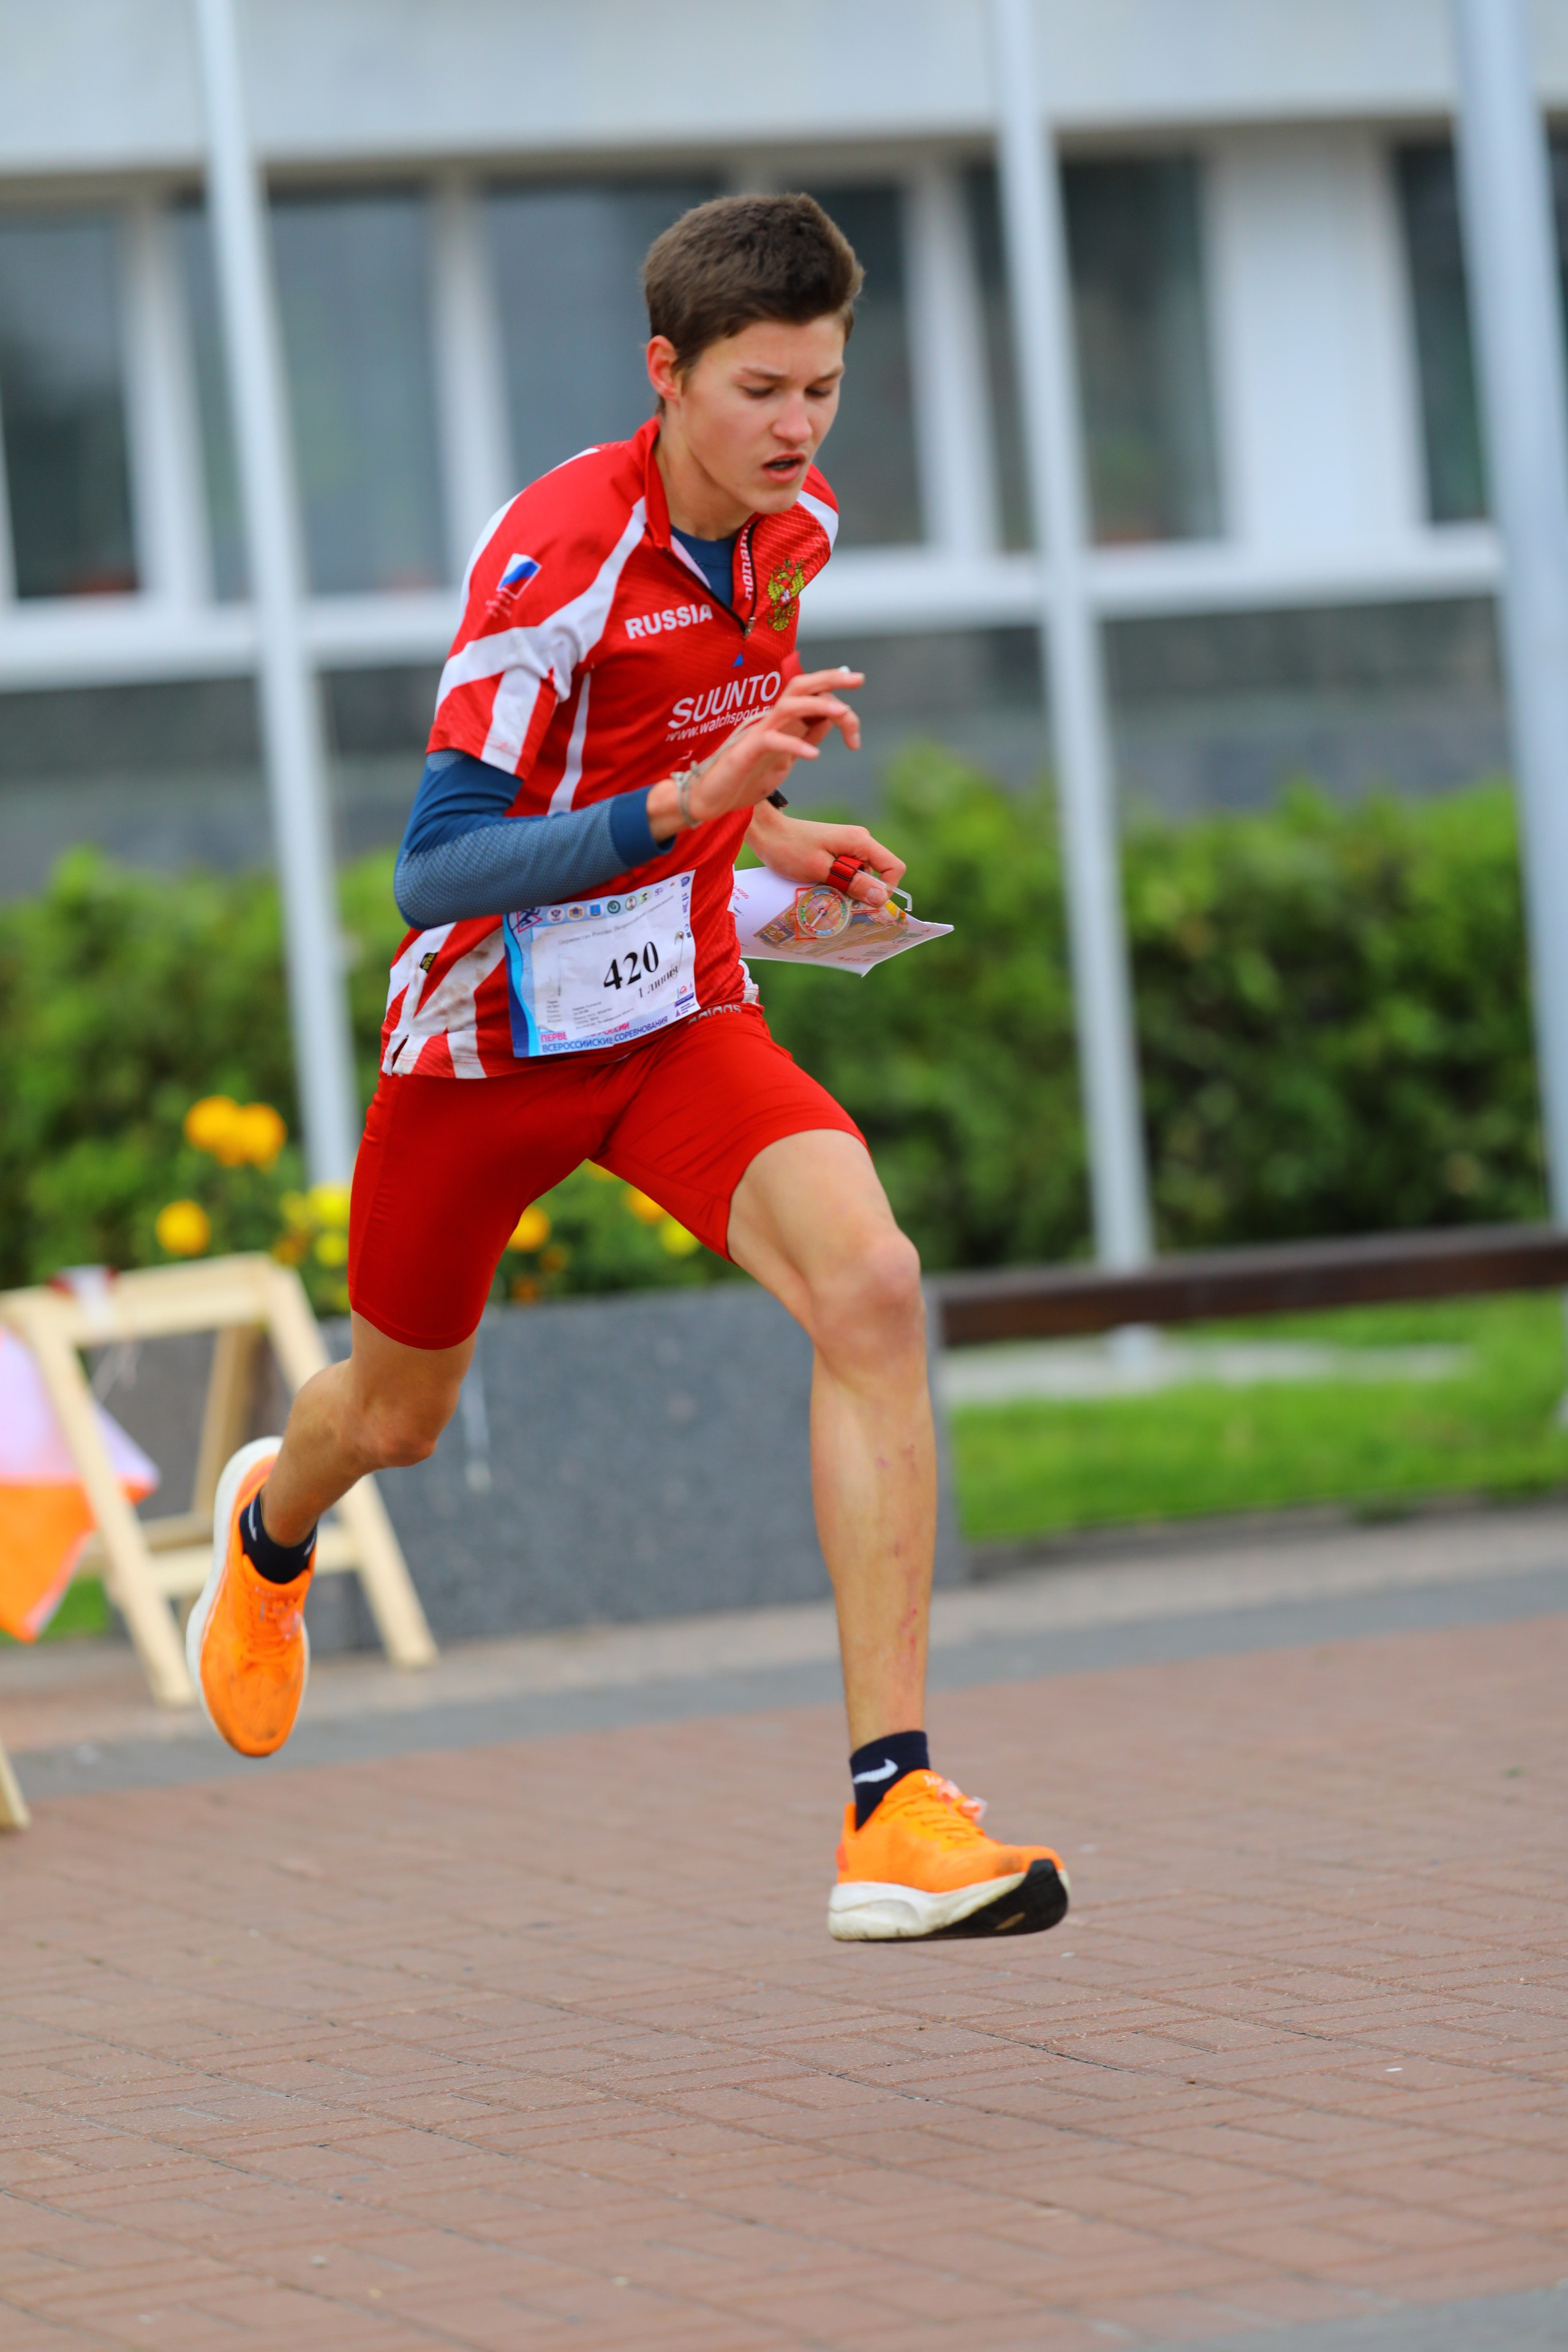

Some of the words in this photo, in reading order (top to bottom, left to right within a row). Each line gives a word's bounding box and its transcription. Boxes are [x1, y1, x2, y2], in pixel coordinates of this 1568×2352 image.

[740, 524, 753, 600] nonam
[625, 603, 713, 640] RUSSIA
[668, 671, 781, 729] SUUNTO
[603, 941, 660, 990] 420
[614, 1016, 669, 1041] СОРЕВНОВАНИЯ
